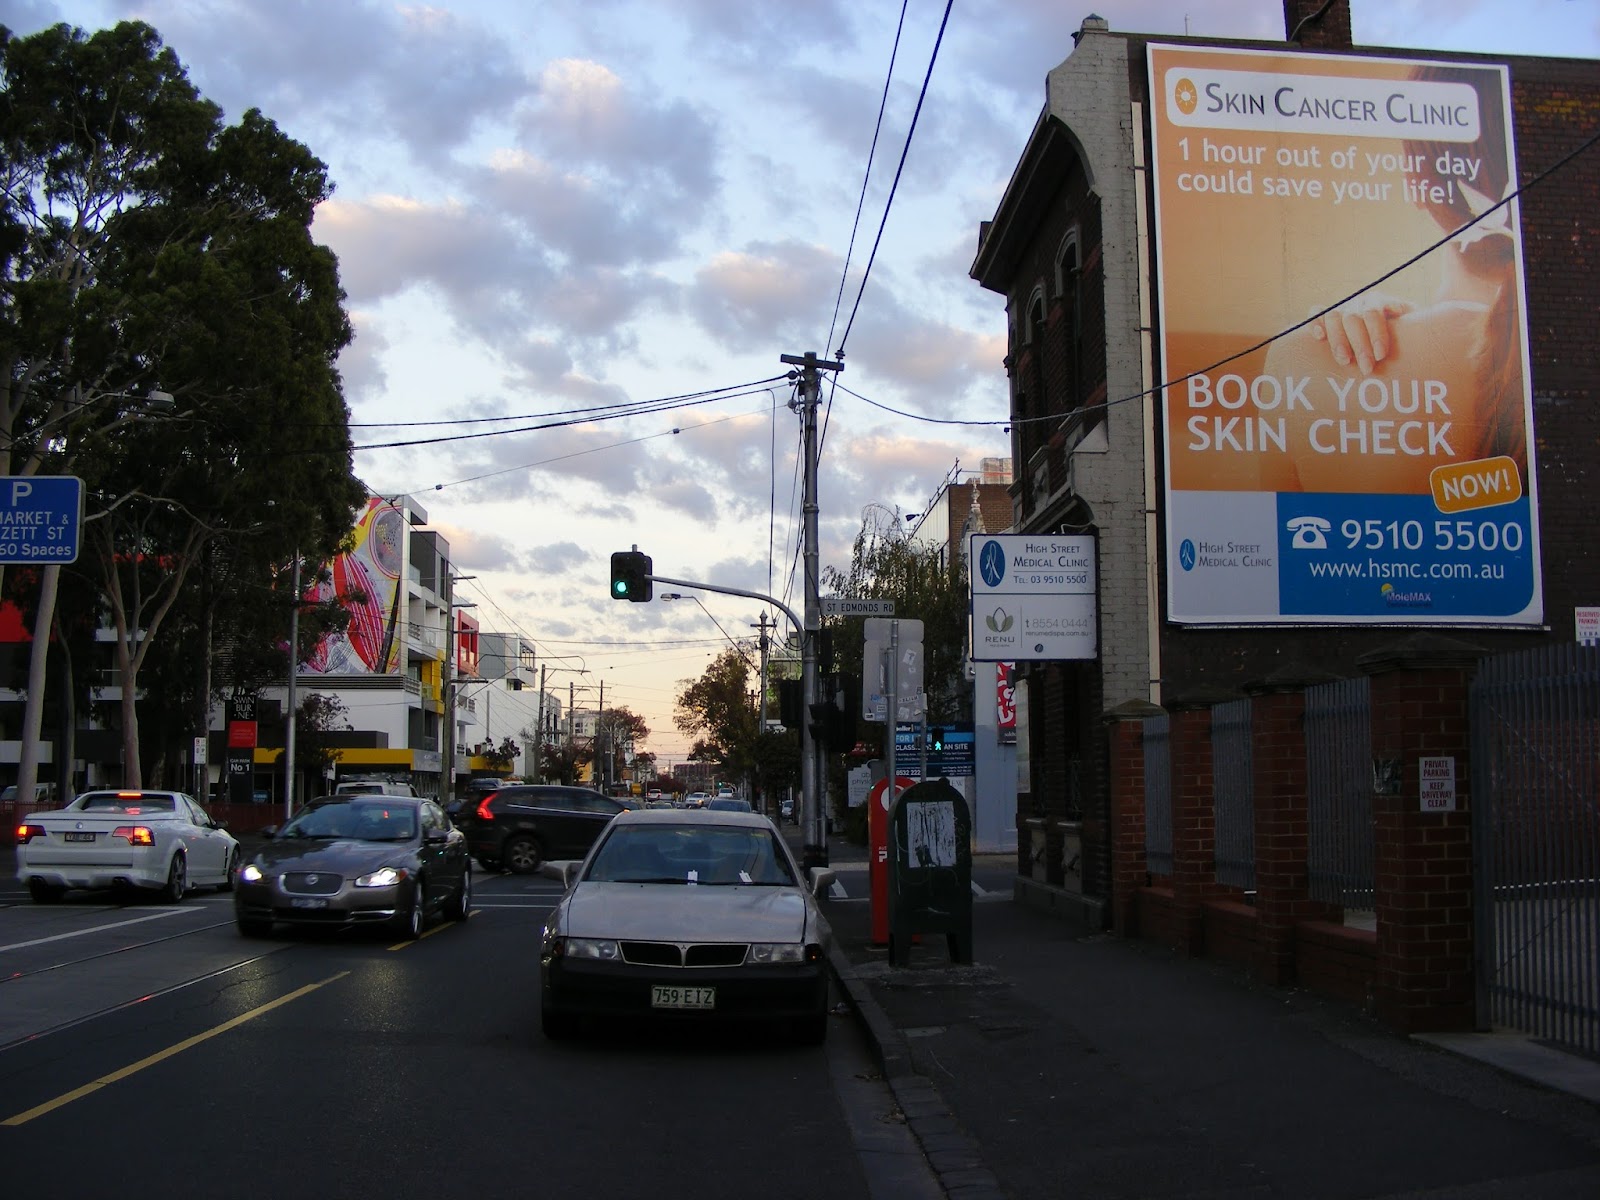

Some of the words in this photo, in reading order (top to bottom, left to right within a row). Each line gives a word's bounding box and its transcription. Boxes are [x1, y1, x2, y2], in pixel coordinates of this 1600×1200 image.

[1205, 83, 1265, 115] SKIN
[1274, 87, 1377, 121] CANCER
[1386, 93, 1469, 126] CLINIC
[1178, 137, 1189, 161] 1
[1203, 137, 1266, 164] hour
[1276, 146, 1322, 168] out
[1330, 145, 1357, 169] of
[1364, 151, 1425, 176] your
[1435, 150, 1481, 181] day
[1177, 169, 1253, 194] could
[1262, 177, 1322, 198] save
[1332, 180, 1392, 205] your
[1403, 178, 1454, 205] life!
[1187, 373, 1315, 411] BOOK
[1326, 377, 1452, 415] YOUR
[1187, 415, 1287, 453] SKIN
[1309, 418, 1456, 456] CHECK
[1441, 468, 1511, 501] NOW!
[11, 481, 33, 507] P
[62, 513, 69, 525] &
[0, 526, 38, 540] ZETT
[47, 526, 65, 540] ST
[1341, 519, 1423, 550] 9510
[1434, 521, 1523, 551] 5500
[21, 543, 72, 558] Spaces
[1309, 558, 1505, 580] www.hsmc.com.au
[1030, 576, 1041, 584] 03
[1043, 575, 1064, 584] 9510
[1066, 575, 1087, 584] 5500
[827, 603, 836, 612] ST
[841, 603, 879, 612] EDMONDS
[883, 603, 894, 612] RD
[1032, 619, 1059, 628] 8554
[1061, 619, 1088, 628] 0444
[235, 703, 252, 712] BUR
[1424, 760, 1449, 768] PRIVATE
[1423, 769, 1450, 777] PARKING
[1429, 782, 1445, 790] KEEP
[1422, 791, 1452, 799] DRIVEWAY
[1427, 799, 1447, 807] CLEAR
